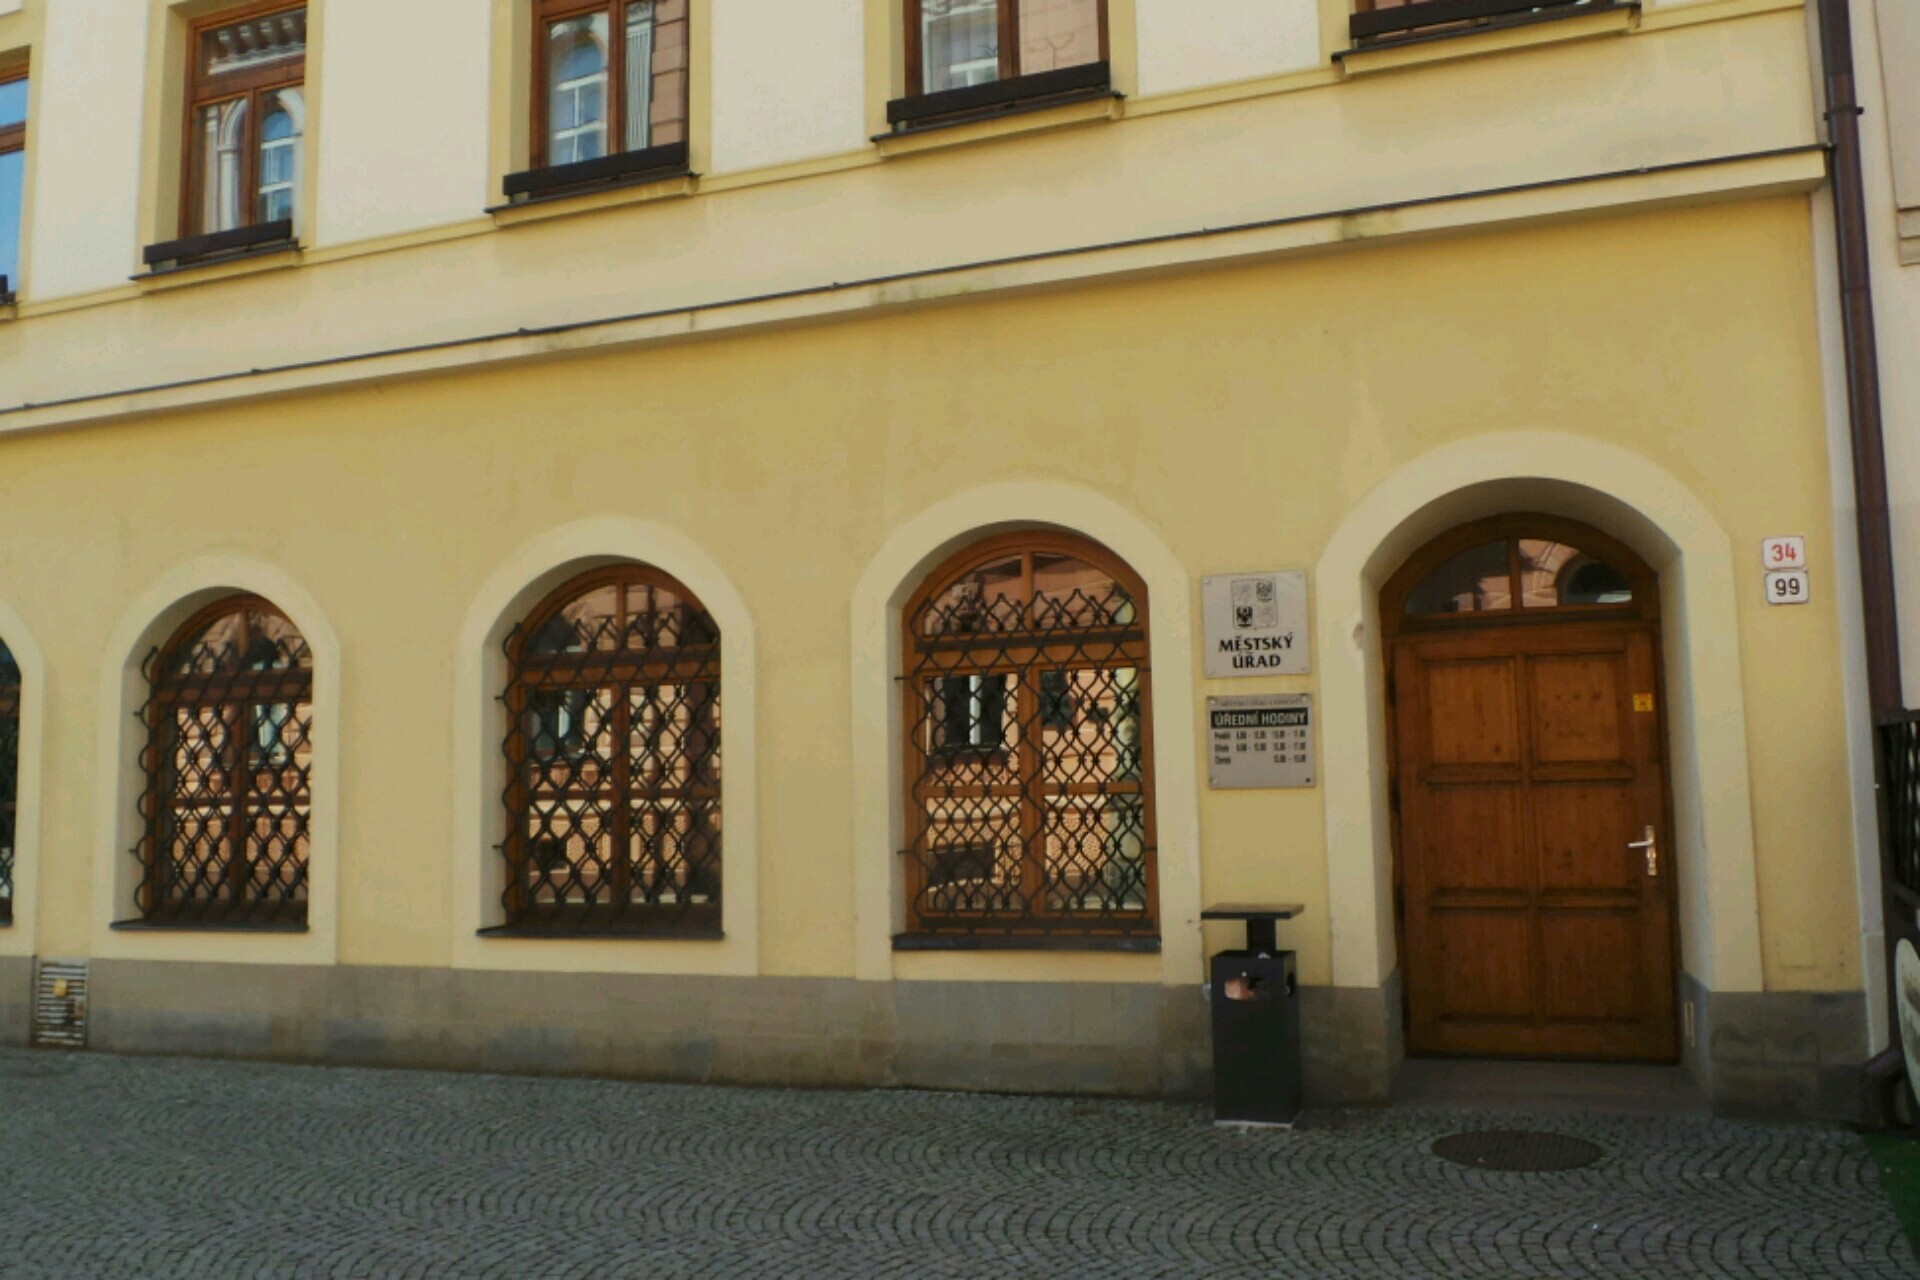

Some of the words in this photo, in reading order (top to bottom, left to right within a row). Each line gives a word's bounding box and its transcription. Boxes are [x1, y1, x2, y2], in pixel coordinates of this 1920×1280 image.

[1772, 544, 1796, 561] 34
[1776, 578, 1800, 596] 99
[1219, 633, 1293, 651] MĚSTSKÝ
[1233, 652, 1281, 668] ÚŘAD
